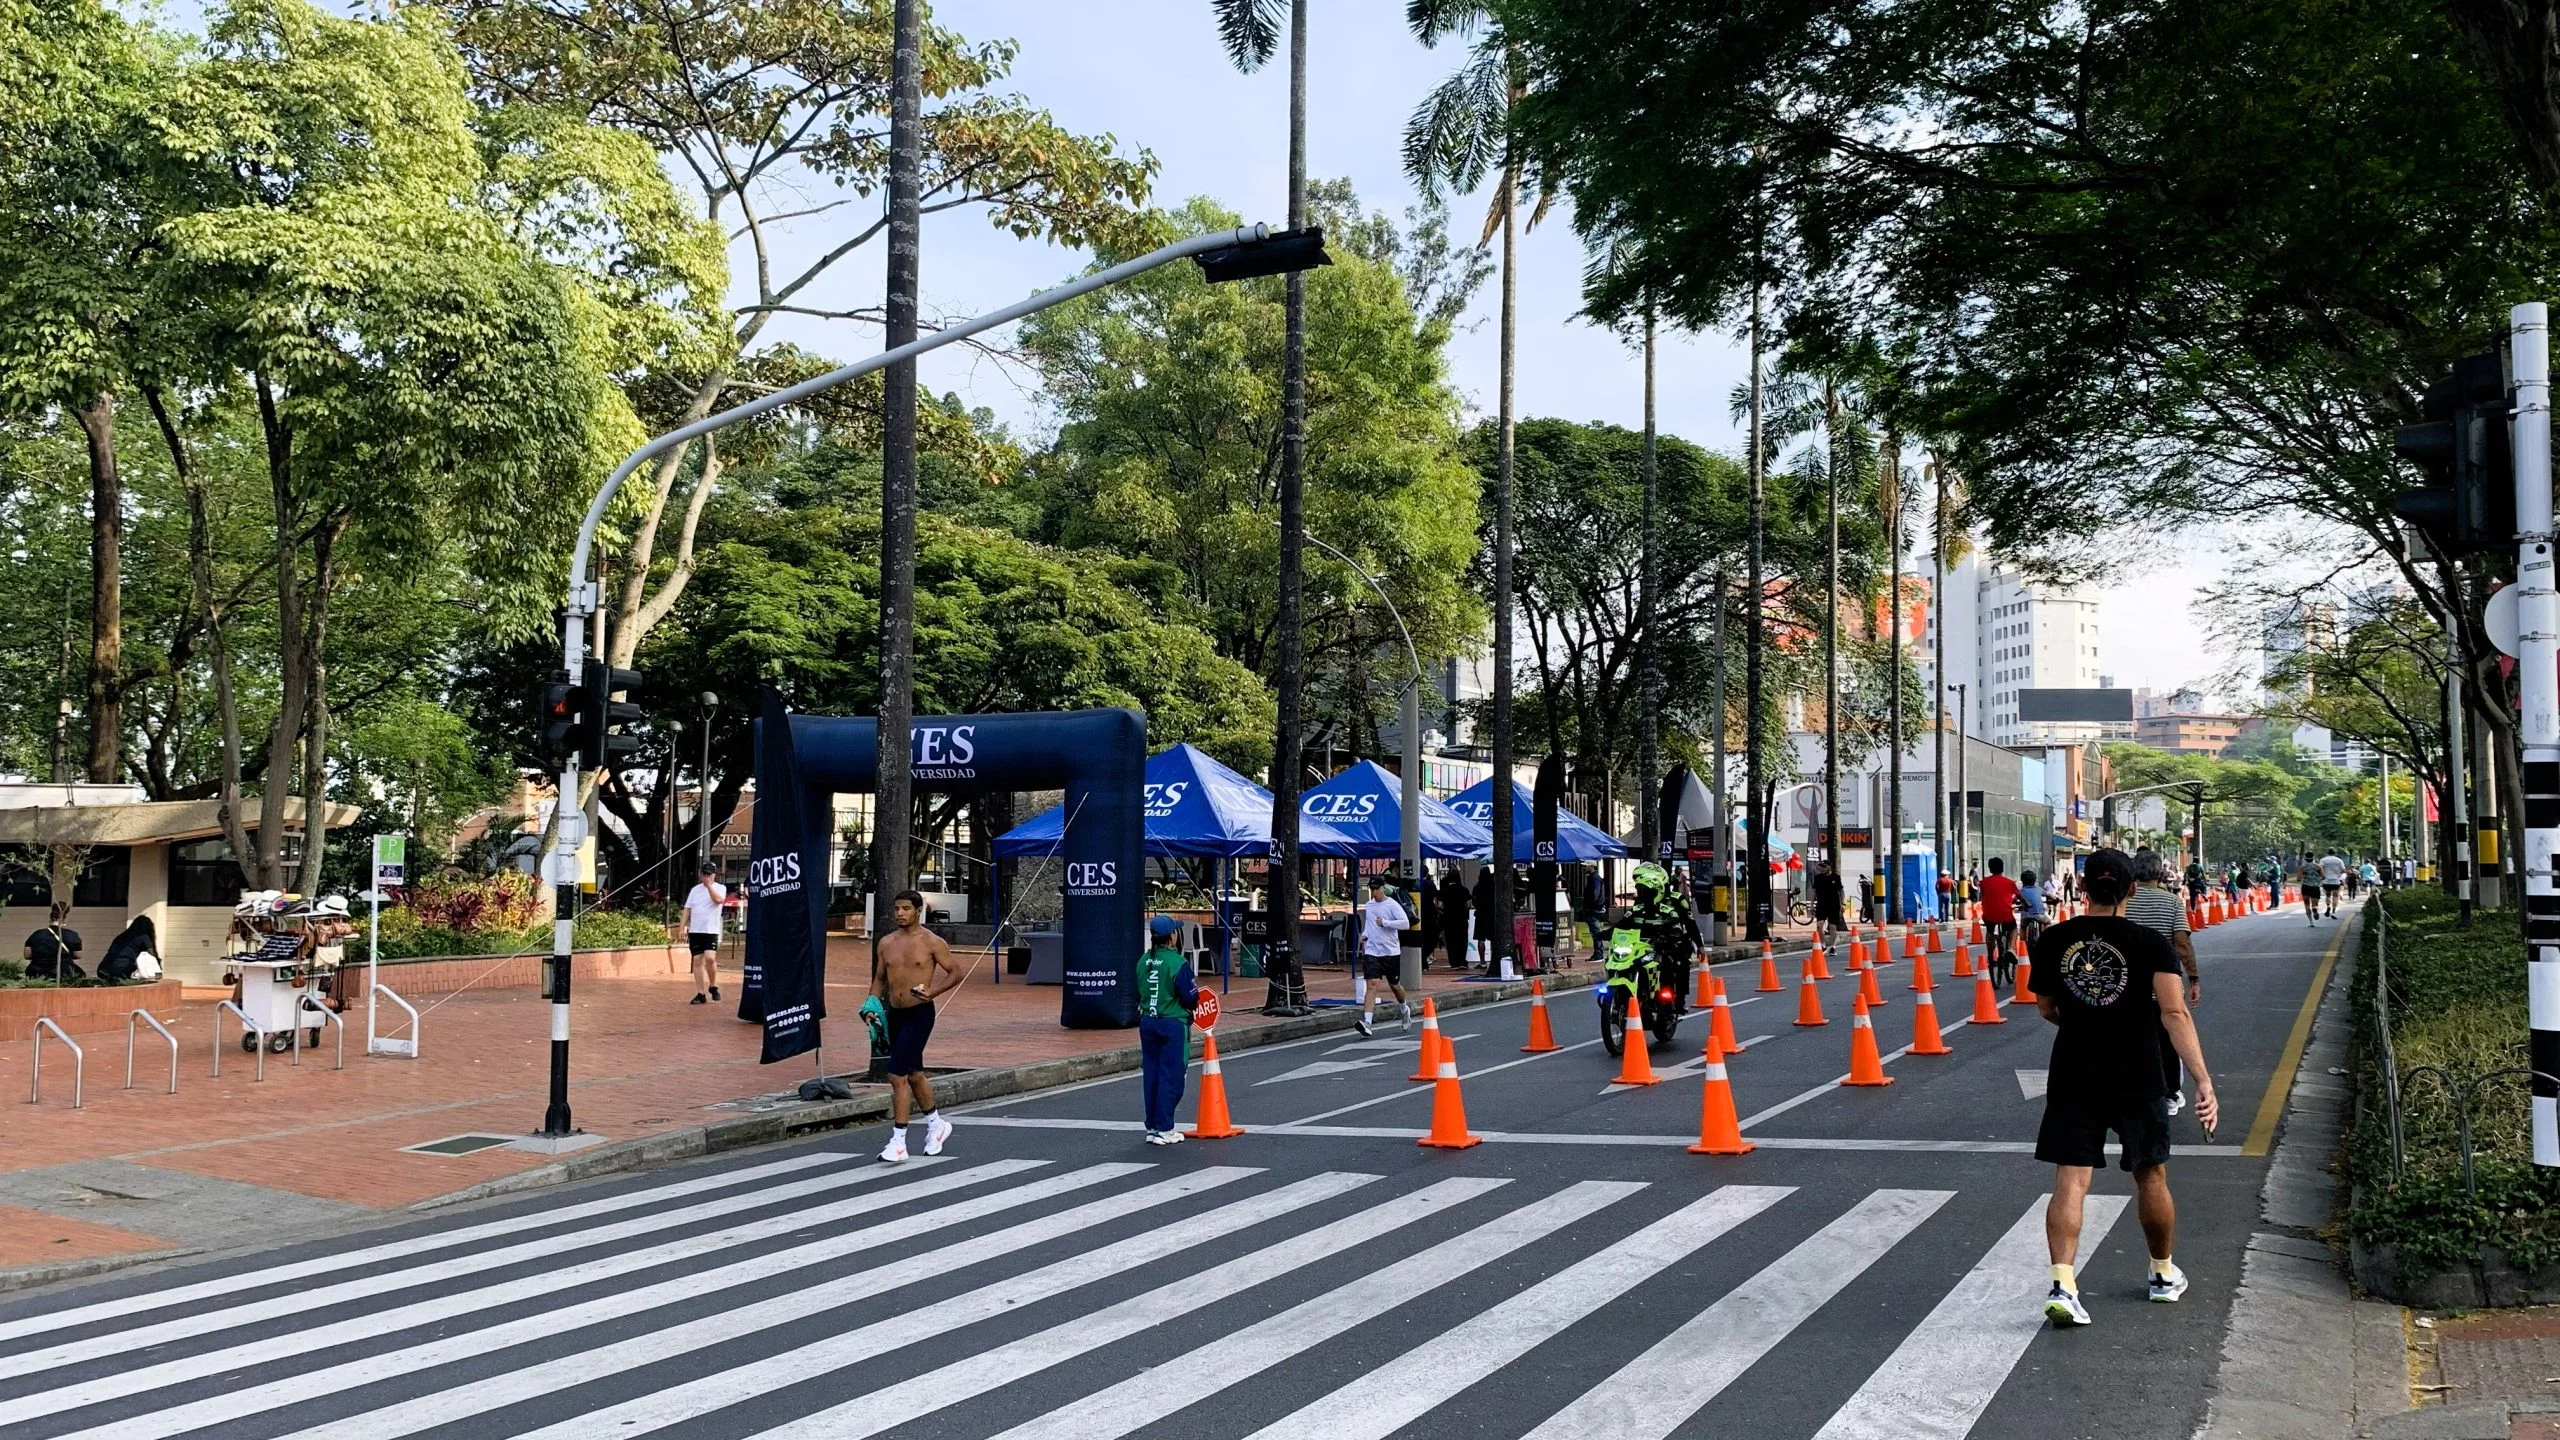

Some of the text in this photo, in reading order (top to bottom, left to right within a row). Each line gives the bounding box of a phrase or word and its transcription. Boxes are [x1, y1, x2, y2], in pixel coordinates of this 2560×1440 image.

[911, 768, 976, 779] VERSIDAD
[1302, 793, 1380, 815] CES
[1449, 801, 1495, 820] CE
[1316, 815, 1369, 823] VERSIDAD
[760, 852, 801, 886] CES
[1067, 862, 1117, 886] CES
[1067, 888, 1116, 896] UNIVERSIDAD
[1246, 921, 1267, 932] CES
[1147, 970, 1159, 1018] DELLÍN
